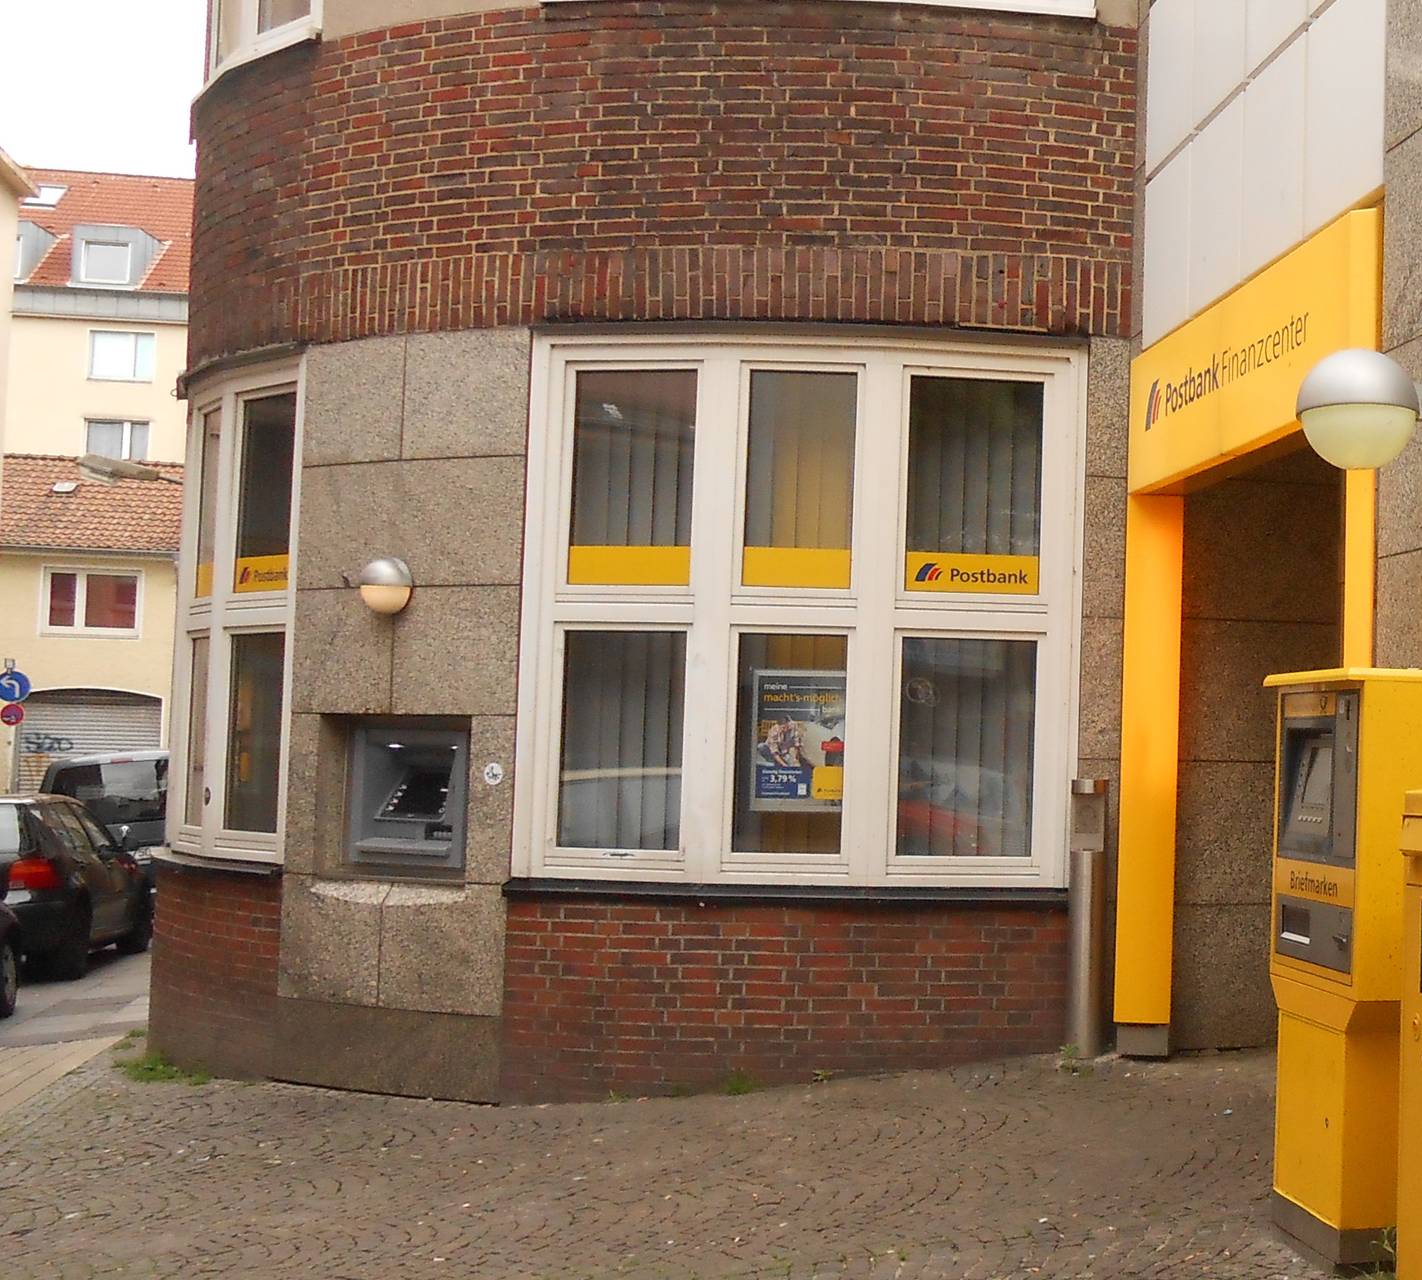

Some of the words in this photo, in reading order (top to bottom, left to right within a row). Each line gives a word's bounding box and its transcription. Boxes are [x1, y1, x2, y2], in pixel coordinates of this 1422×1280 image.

[1165, 353, 1219, 417] Postbank
[1221, 312, 1309, 387] Finanzcenter
[950, 568, 1028, 584] Postbank
[763, 682, 788, 691] meine
[1290, 870, 1338, 898] Briefmarken
